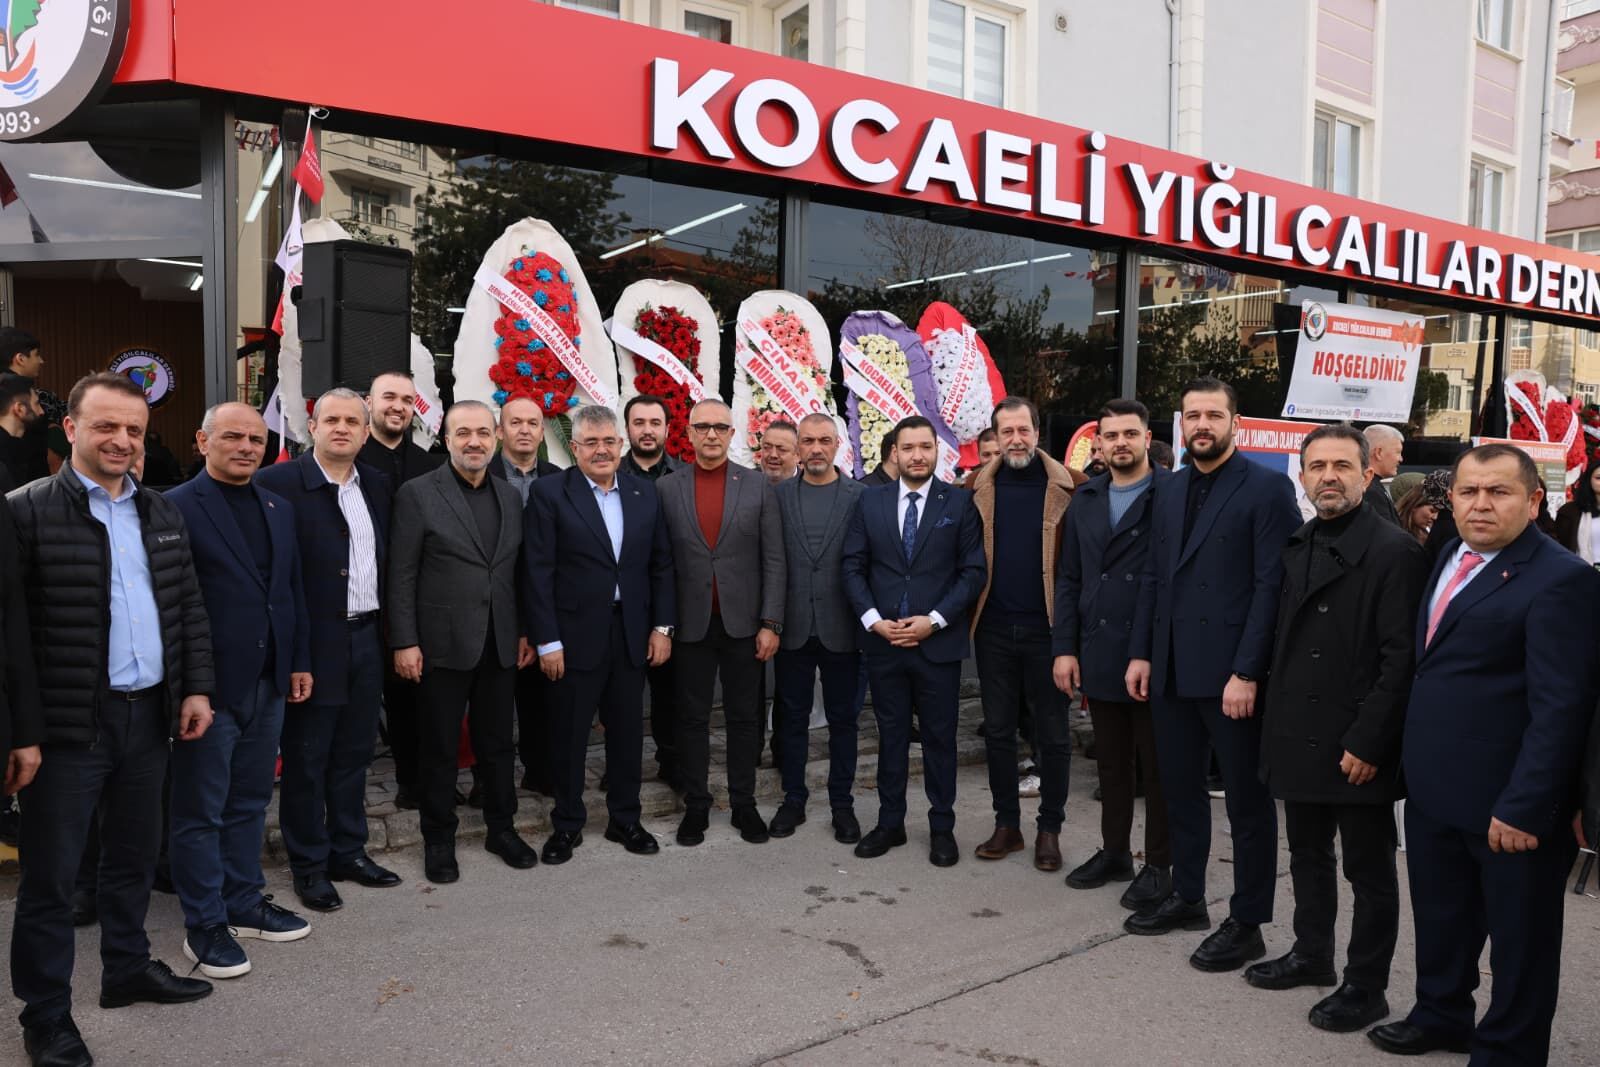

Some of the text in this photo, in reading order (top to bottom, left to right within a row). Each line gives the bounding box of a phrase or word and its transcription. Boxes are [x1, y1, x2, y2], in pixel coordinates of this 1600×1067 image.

[90, 0, 112, 37] Ğİ
[651, 57, 1106, 225] KOCAELİ
[1124, 161, 1501, 300] YIĞILCALILAR
[569, 350, 599, 385] SOYLU
[747, 358, 808, 419] MUHAMME
[858, 360, 894, 396] KOCAELİ
[892, 392, 914, 417] KENT
[1312, 351, 1407, 382] HOŞGELDİNİZ
